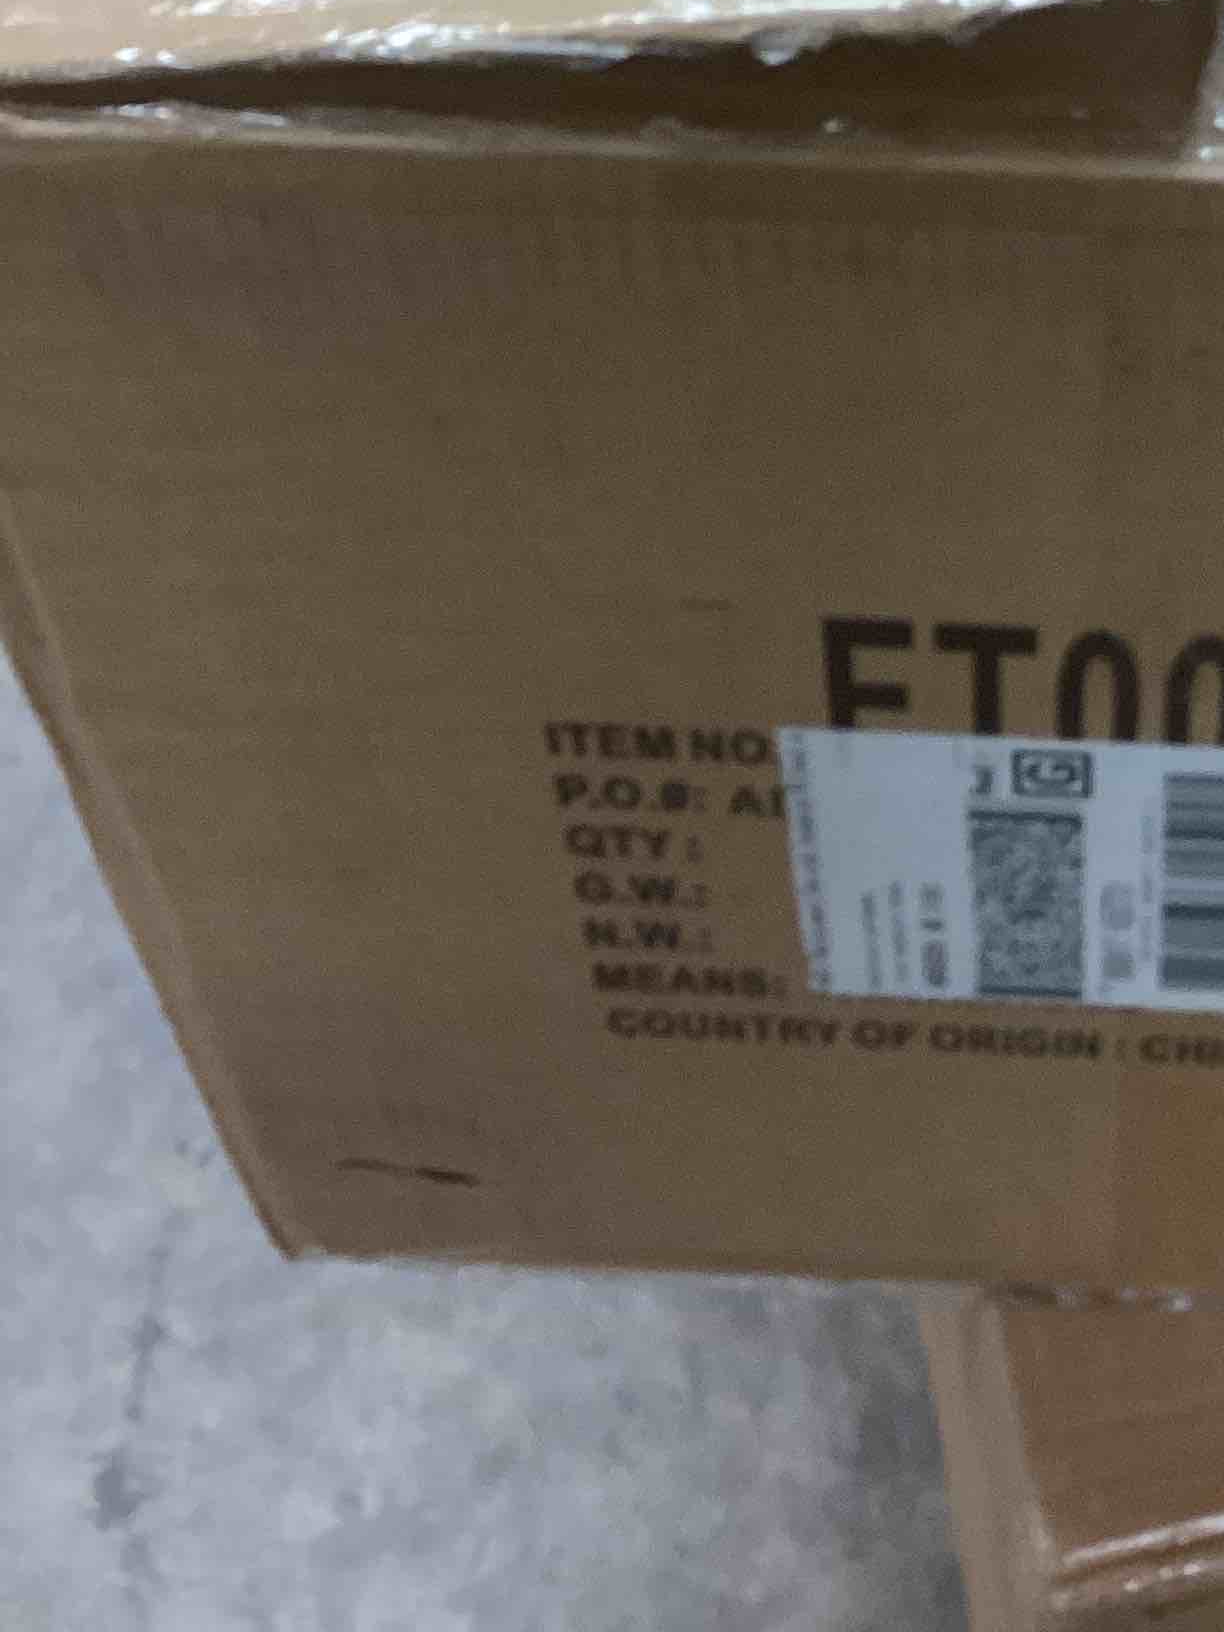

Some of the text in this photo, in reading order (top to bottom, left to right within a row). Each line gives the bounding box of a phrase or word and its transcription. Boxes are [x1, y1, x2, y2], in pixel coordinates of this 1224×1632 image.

[546, 722, 675, 760] ITEM
[608, 1007, 837, 1046] COUNTRY
[852, 1020, 914, 1052] OF
[929, 1023, 1102, 1060] ORIGIN
